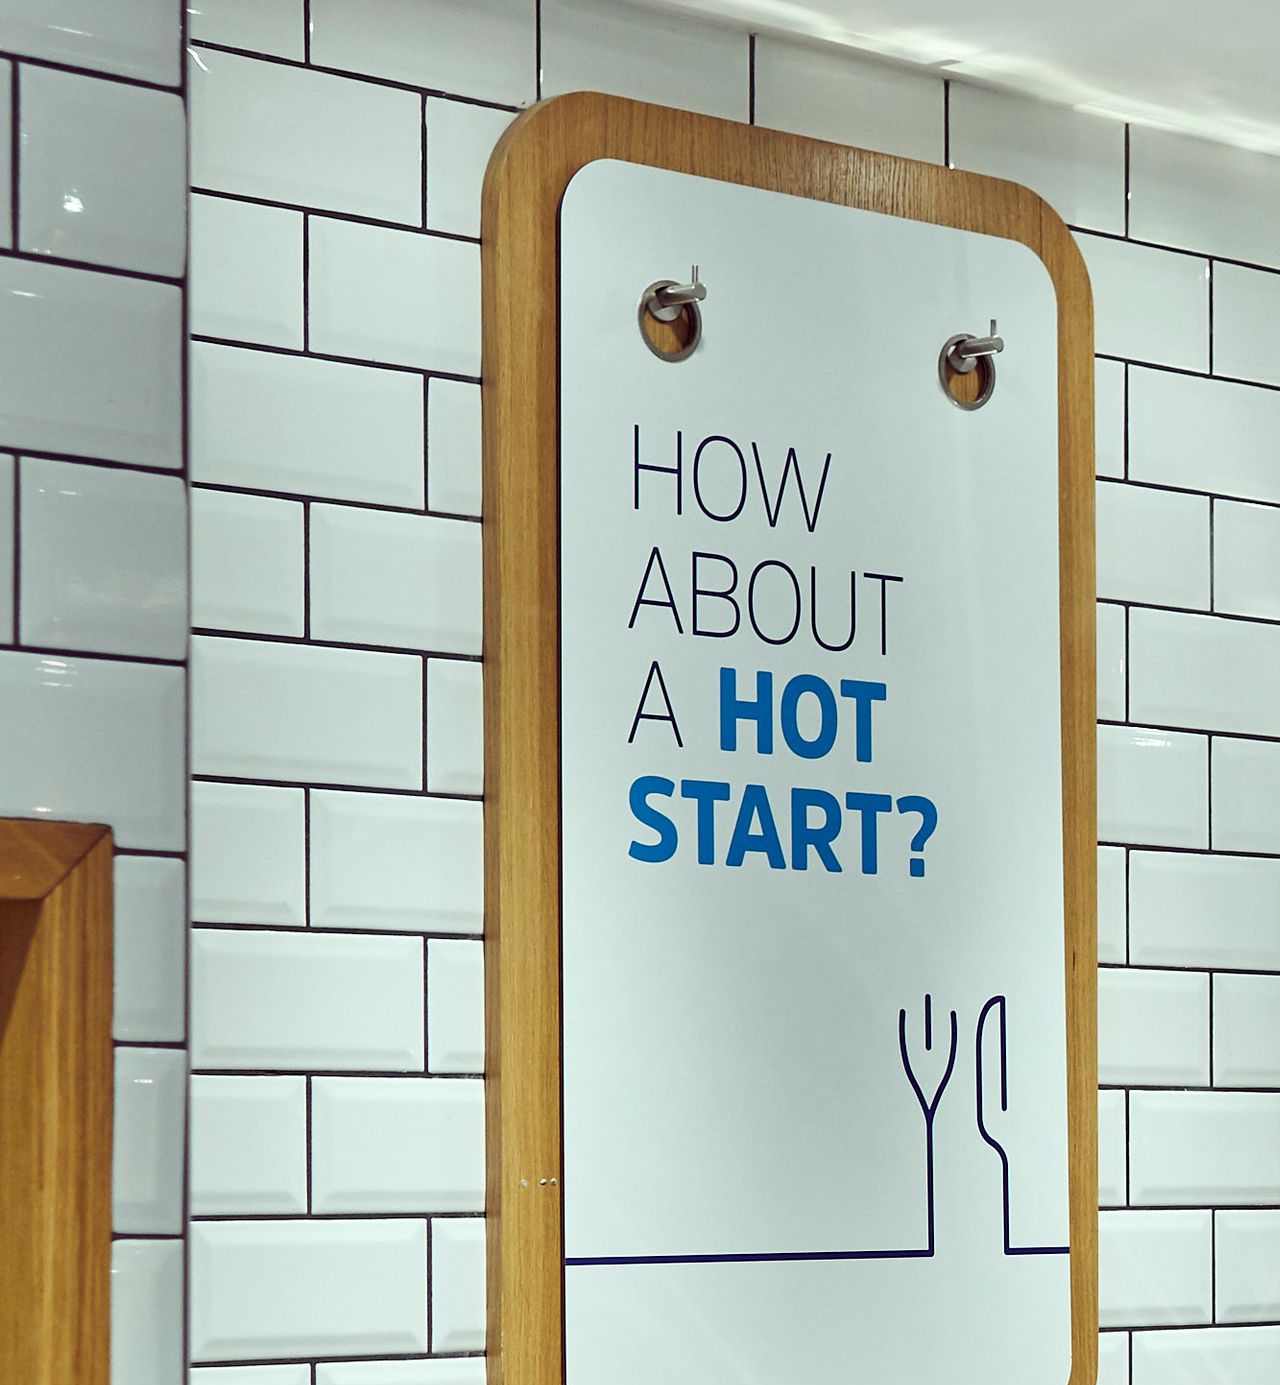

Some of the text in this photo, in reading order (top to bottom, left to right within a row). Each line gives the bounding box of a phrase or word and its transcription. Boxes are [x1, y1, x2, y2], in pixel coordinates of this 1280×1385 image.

[633, 424, 832, 533] HOW
[628, 546, 904, 656] ABOUT
[627, 660, 887, 763] A HOT
[628, 775, 938, 878] START?
